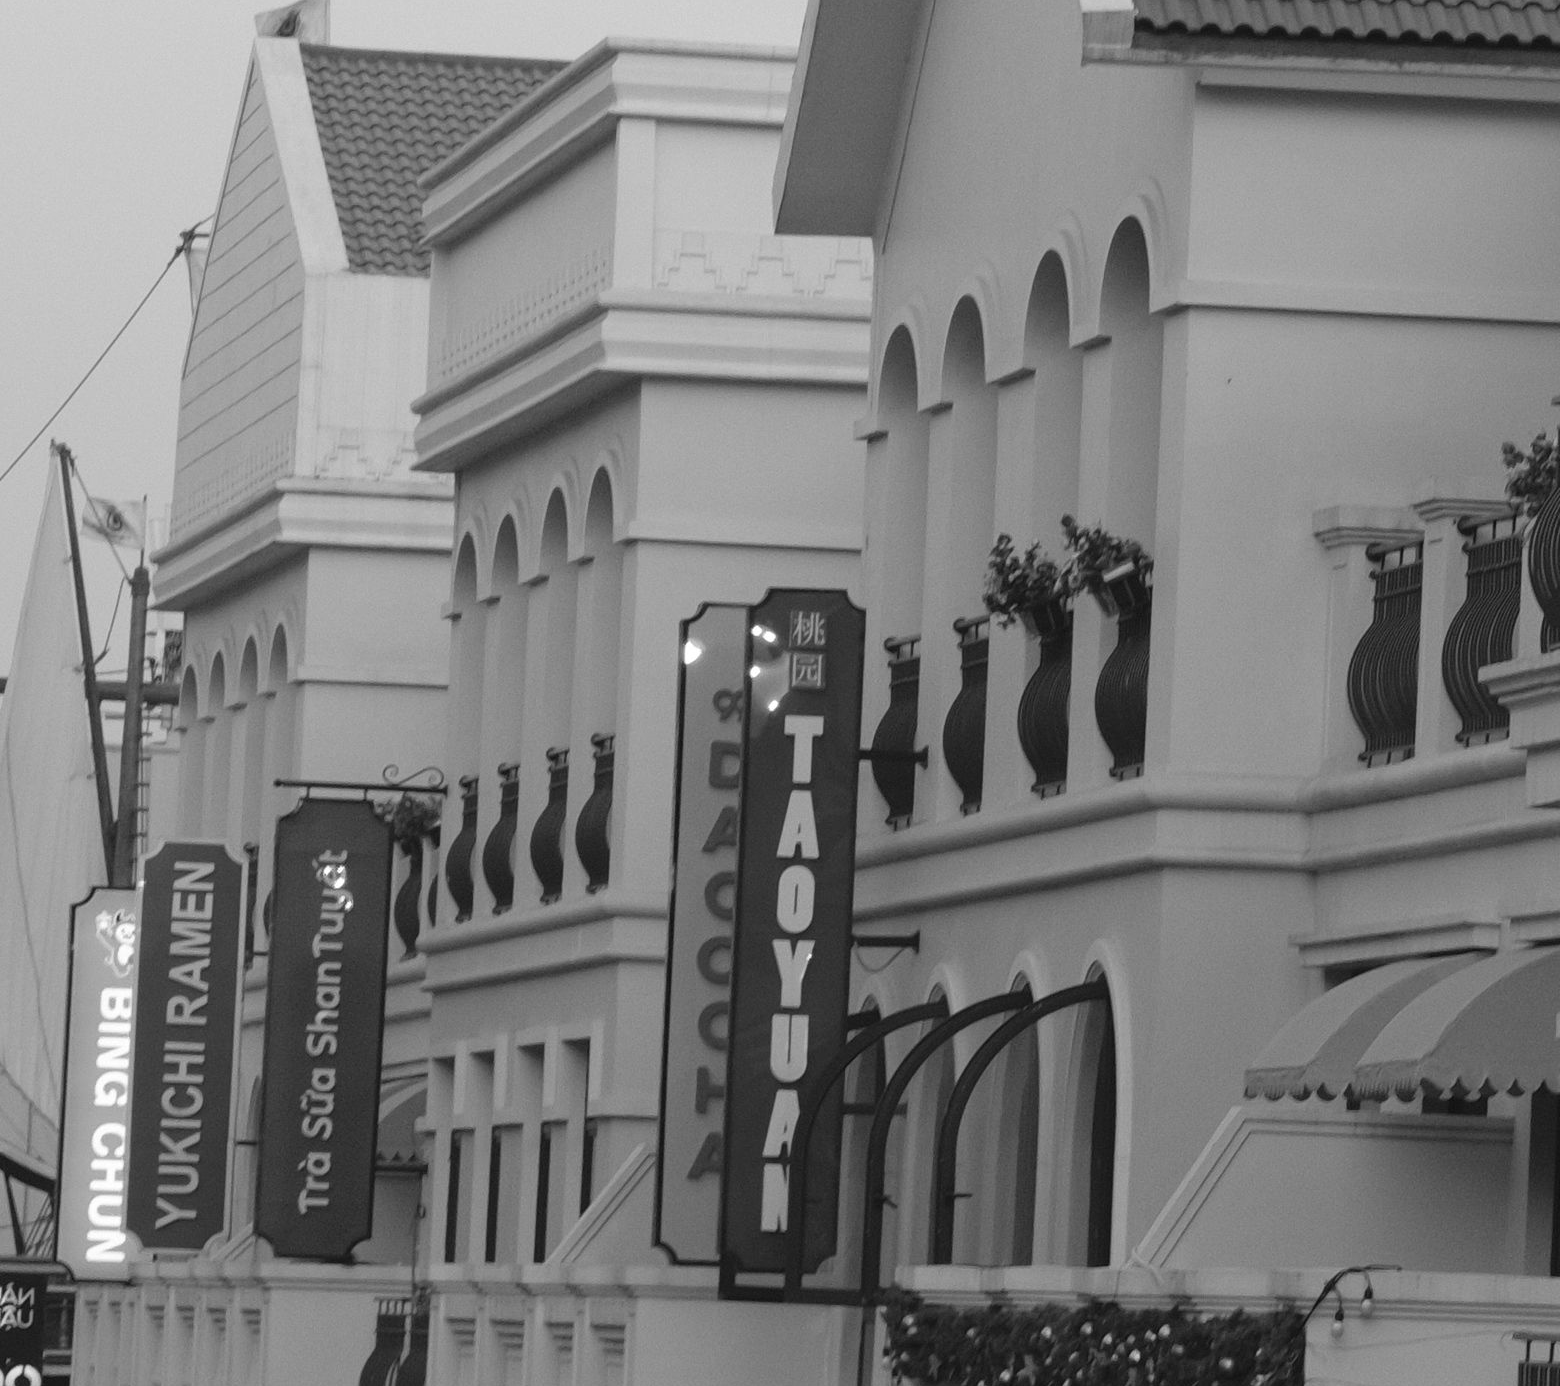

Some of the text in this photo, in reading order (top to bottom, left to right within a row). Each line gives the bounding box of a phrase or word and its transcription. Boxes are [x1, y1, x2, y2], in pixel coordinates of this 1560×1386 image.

[790, 609, 826, 689] 桃园
[85, 986, 134, 1263] BING CHUN
[155, 861, 216, 1230] YUKICHI RAMEN
[298, 849, 355, 1215] Trà Sữa Shan Tuyết
[760, 714, 825, 1233] TAOYUAN
